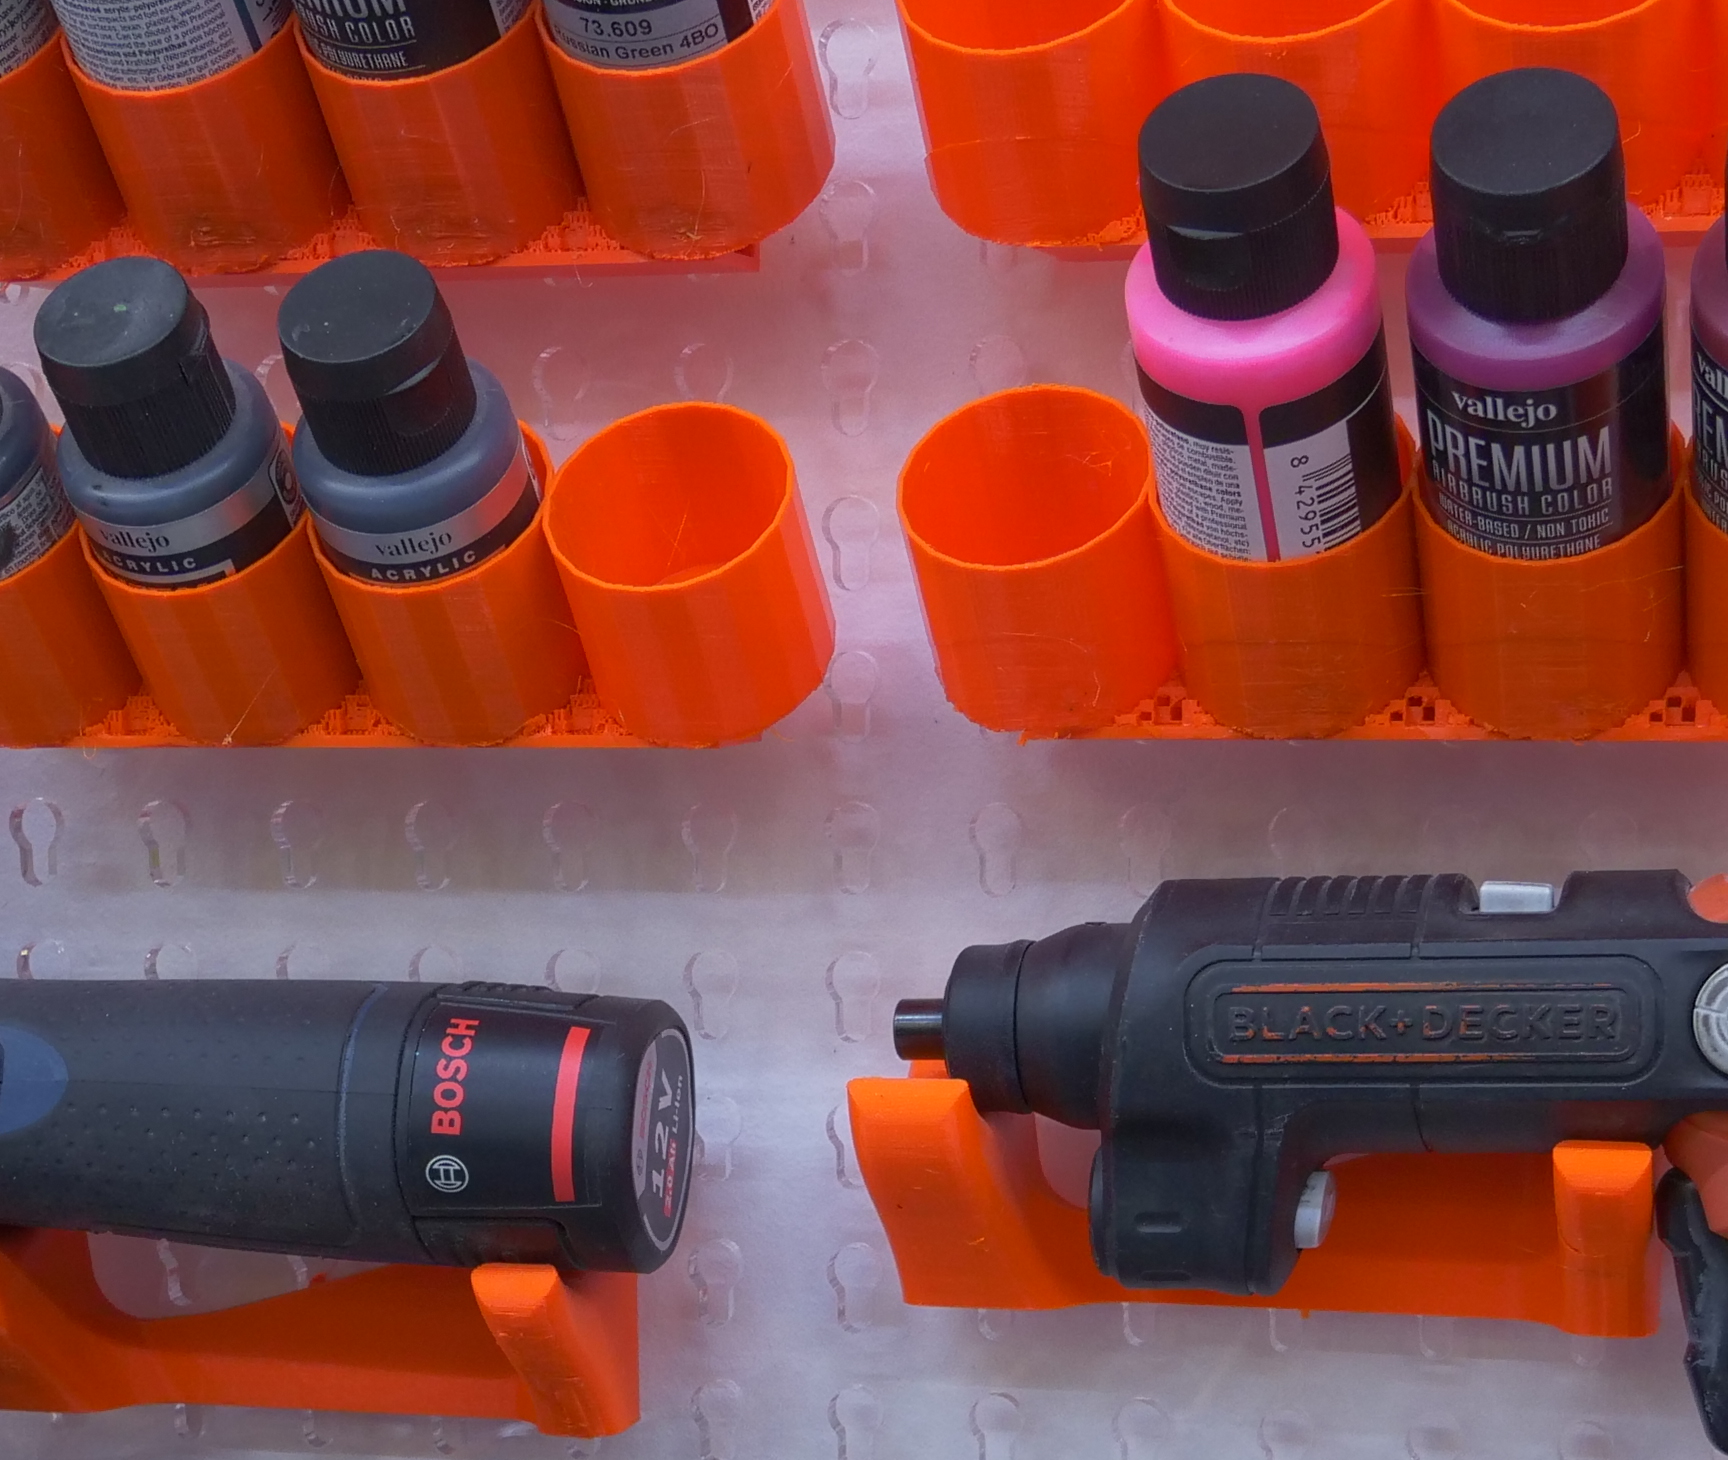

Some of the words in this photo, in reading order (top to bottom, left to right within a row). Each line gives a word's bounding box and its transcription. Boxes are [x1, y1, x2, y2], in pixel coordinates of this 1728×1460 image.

[345, 16, 415, 43] COLOR
[554, 24, 610, 59] Russian
[615, 42, 674, 60] Green
[579, 17, 652, 38] 73.609
[1451, 391, 1558, 428] vallejo
[1290, 455, 1309, 468] 8
[1427, 409, 1611, 493] PREMIUM
[1433, 460, 1530, 516] AIRBRUSH
[1541, 477, 1613, 516] COLOR
[1294, 484, 1321, 549] 42955
[1439, 492, 1519, 539] WATER-BASED
[1537, 523, 1565, 539] NON
[1570, 508, 1609, 534] TOXIC
[100, 529, 170, 552] vallejo
[375, 531, 453, 557] vallejo
[1497, 534, 1601, 561] POLYURETHANE
[103, 550, 196, 573] ACRYLIC
[372, 550, 477, 580] ACRYLIC
[1228, 1003, 1620, 1043] BLACK+DECKER
[430, 1018, 481, 1136] BOSCH
[639, 1061, 653, 1139] BOSCH
[672, 1075, 683, 1134] Li-Ion
